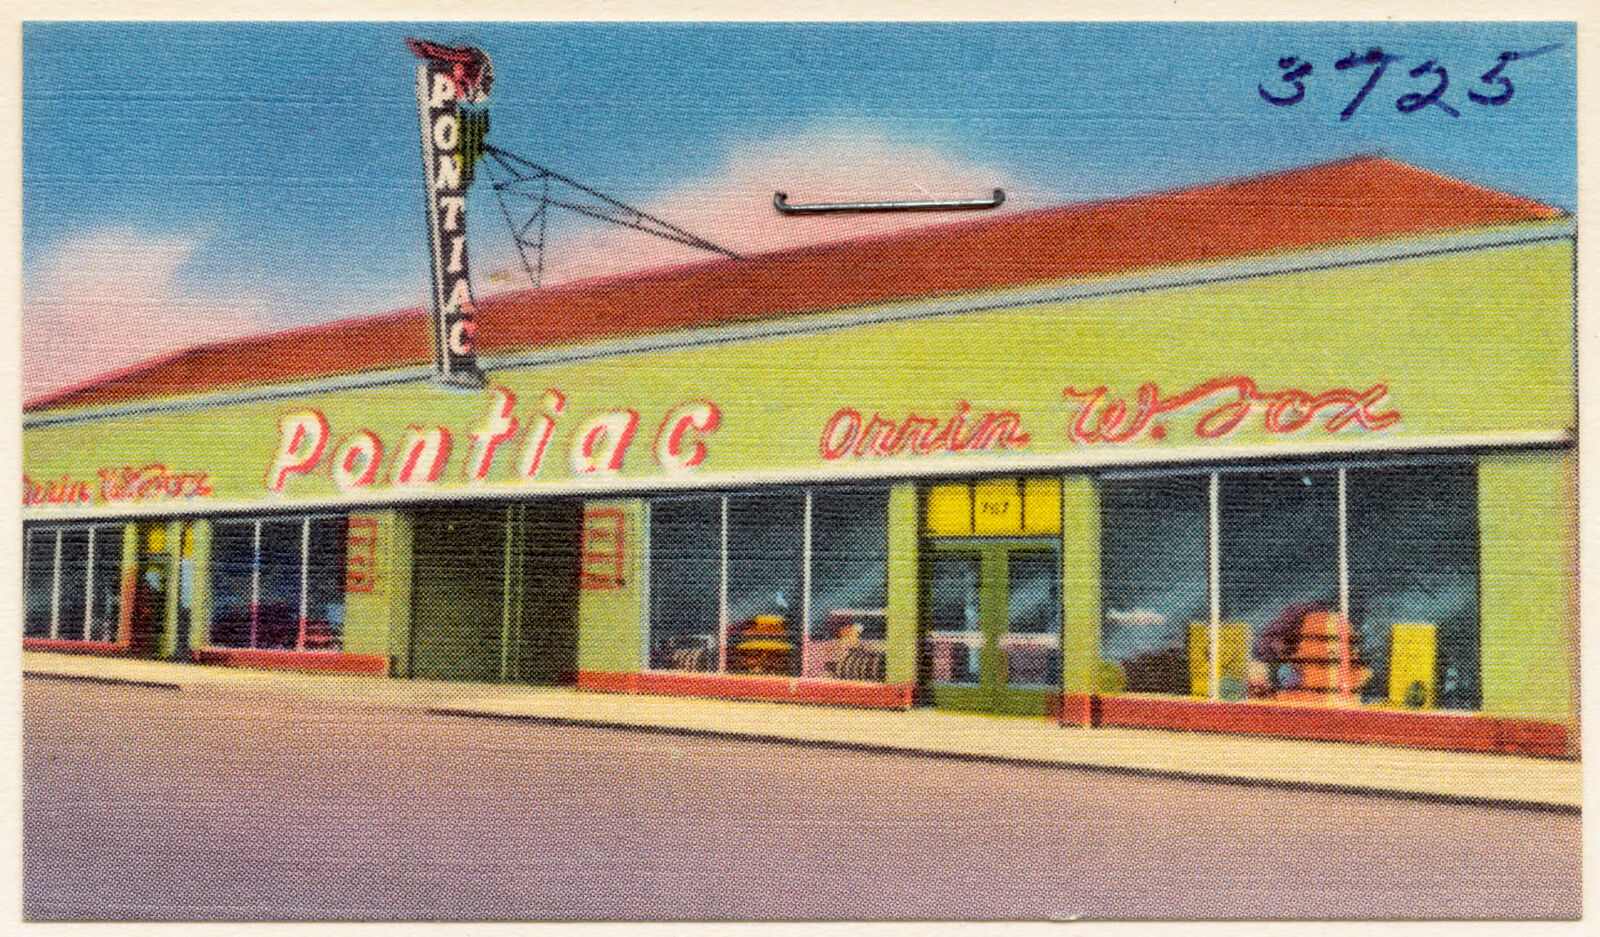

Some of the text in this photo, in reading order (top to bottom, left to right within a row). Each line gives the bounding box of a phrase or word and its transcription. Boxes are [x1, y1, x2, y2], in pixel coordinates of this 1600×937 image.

[1258, 43, 1564, 121] 3725
[431, 73, 476, 356] PONTIAC
[266, 386, 722, 495] Pontiac
[819, 399, 1030, 461] Orrin
